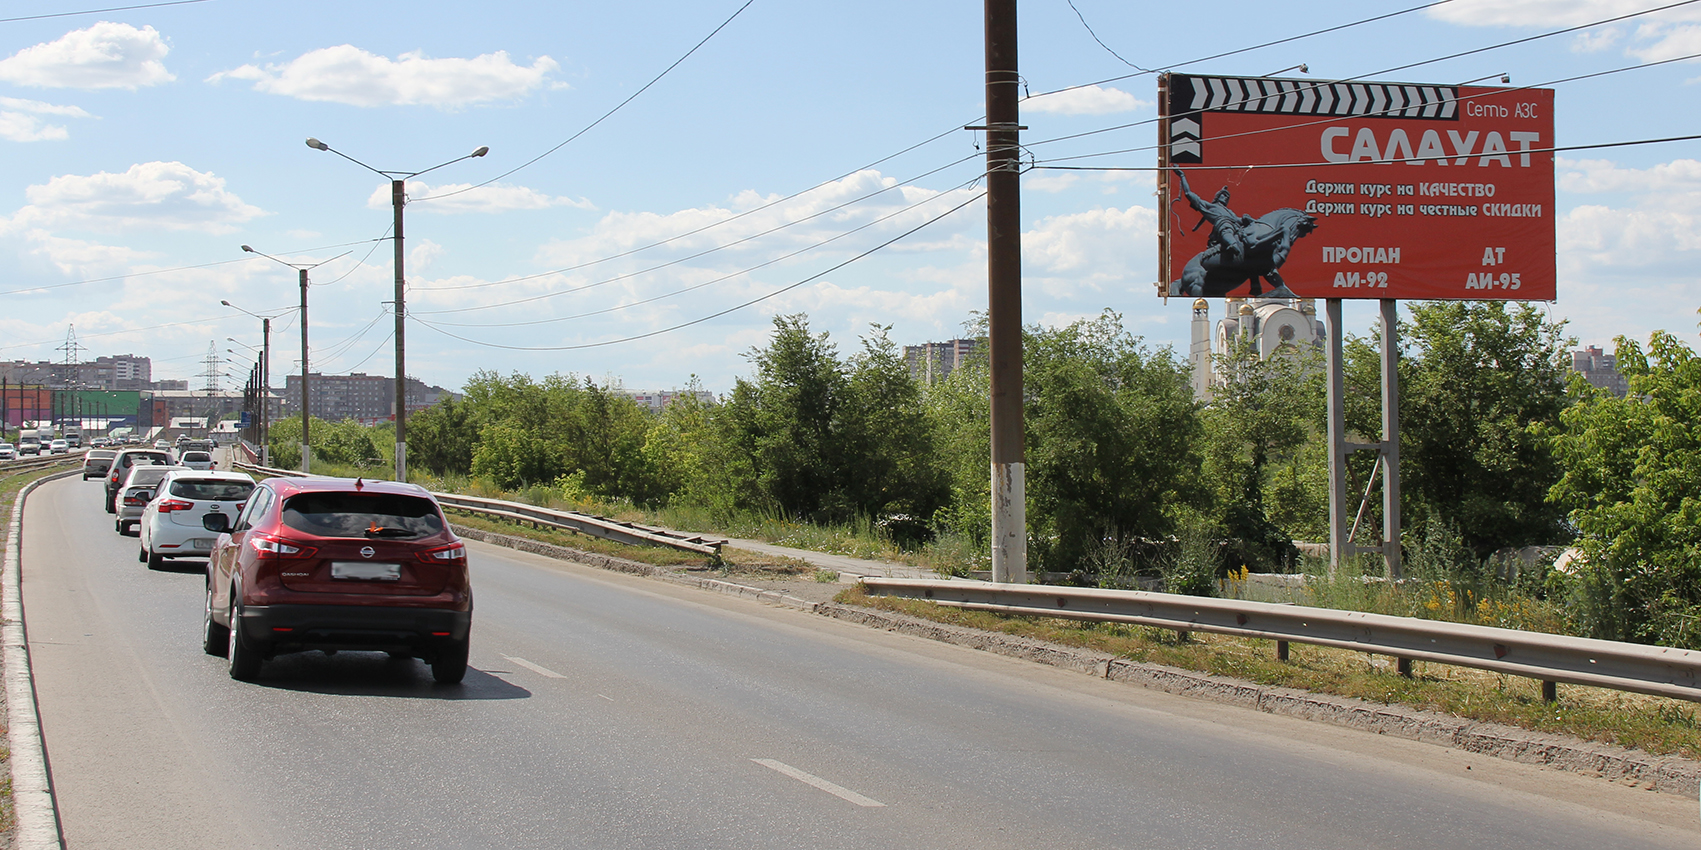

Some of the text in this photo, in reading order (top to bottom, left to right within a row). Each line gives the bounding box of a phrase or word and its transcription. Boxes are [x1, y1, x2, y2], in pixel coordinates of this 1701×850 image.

[1466, 100, 1538, 119] Сеть АЗС
[1320, 126, 1540, 168] САЛАУАТ
[1305, 179, 1496, 198] Держи курс на КАЧЕСТВО
[1305, 199, 1542, 218] Держи курс на честные СКИДКИ
[1322, 246, 1401, 264] ПРОПАН
[1482, 247, 1506, 266] ДТ
[1333, 271, 1389, 288] АИ-92
[1465, 272, 1522, 290] АИ-95
